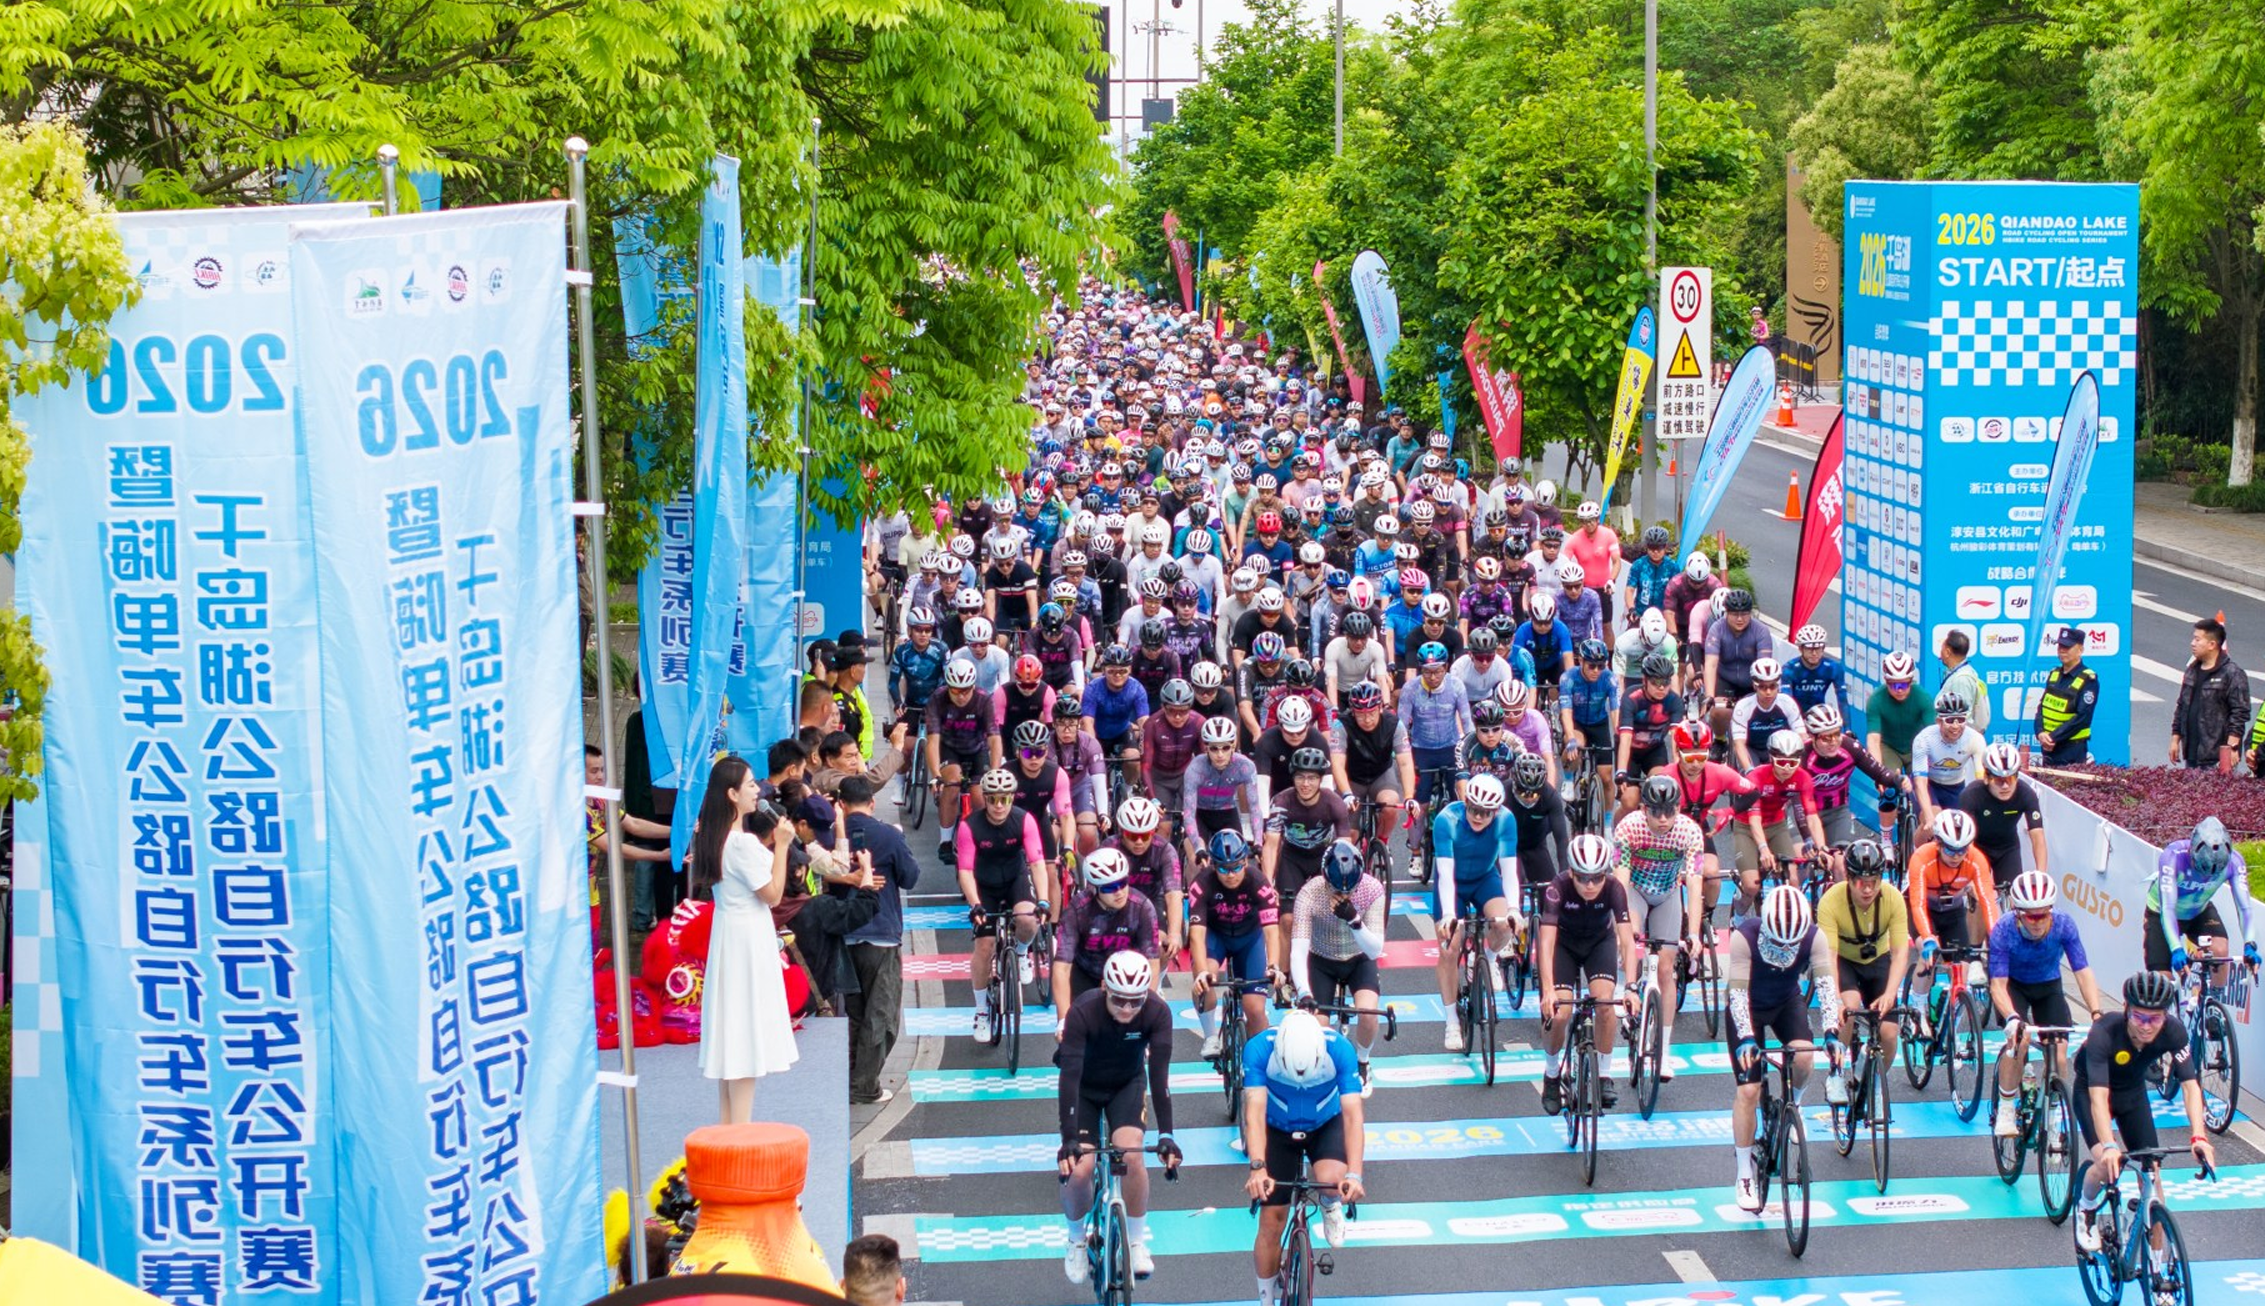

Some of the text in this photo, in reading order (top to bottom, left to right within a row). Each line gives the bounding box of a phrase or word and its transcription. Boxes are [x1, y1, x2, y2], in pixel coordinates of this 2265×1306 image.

[1937, 213, 2127, 246] 2026 QIANDAO LAKE
[1676, 284, 1697, 310] 30
[1663, 383, 1705, 398] 前方路口
[1663, 401, 1706, 417] 减速慢行
[1662, 420, 1705, 436] 谨慎驾驶
[1969, 482, 2088, 495] 浙江省自行车运
[2062, 872, 2124, 928] GUSTO
[1085, 935, 1131, 951] EVR
